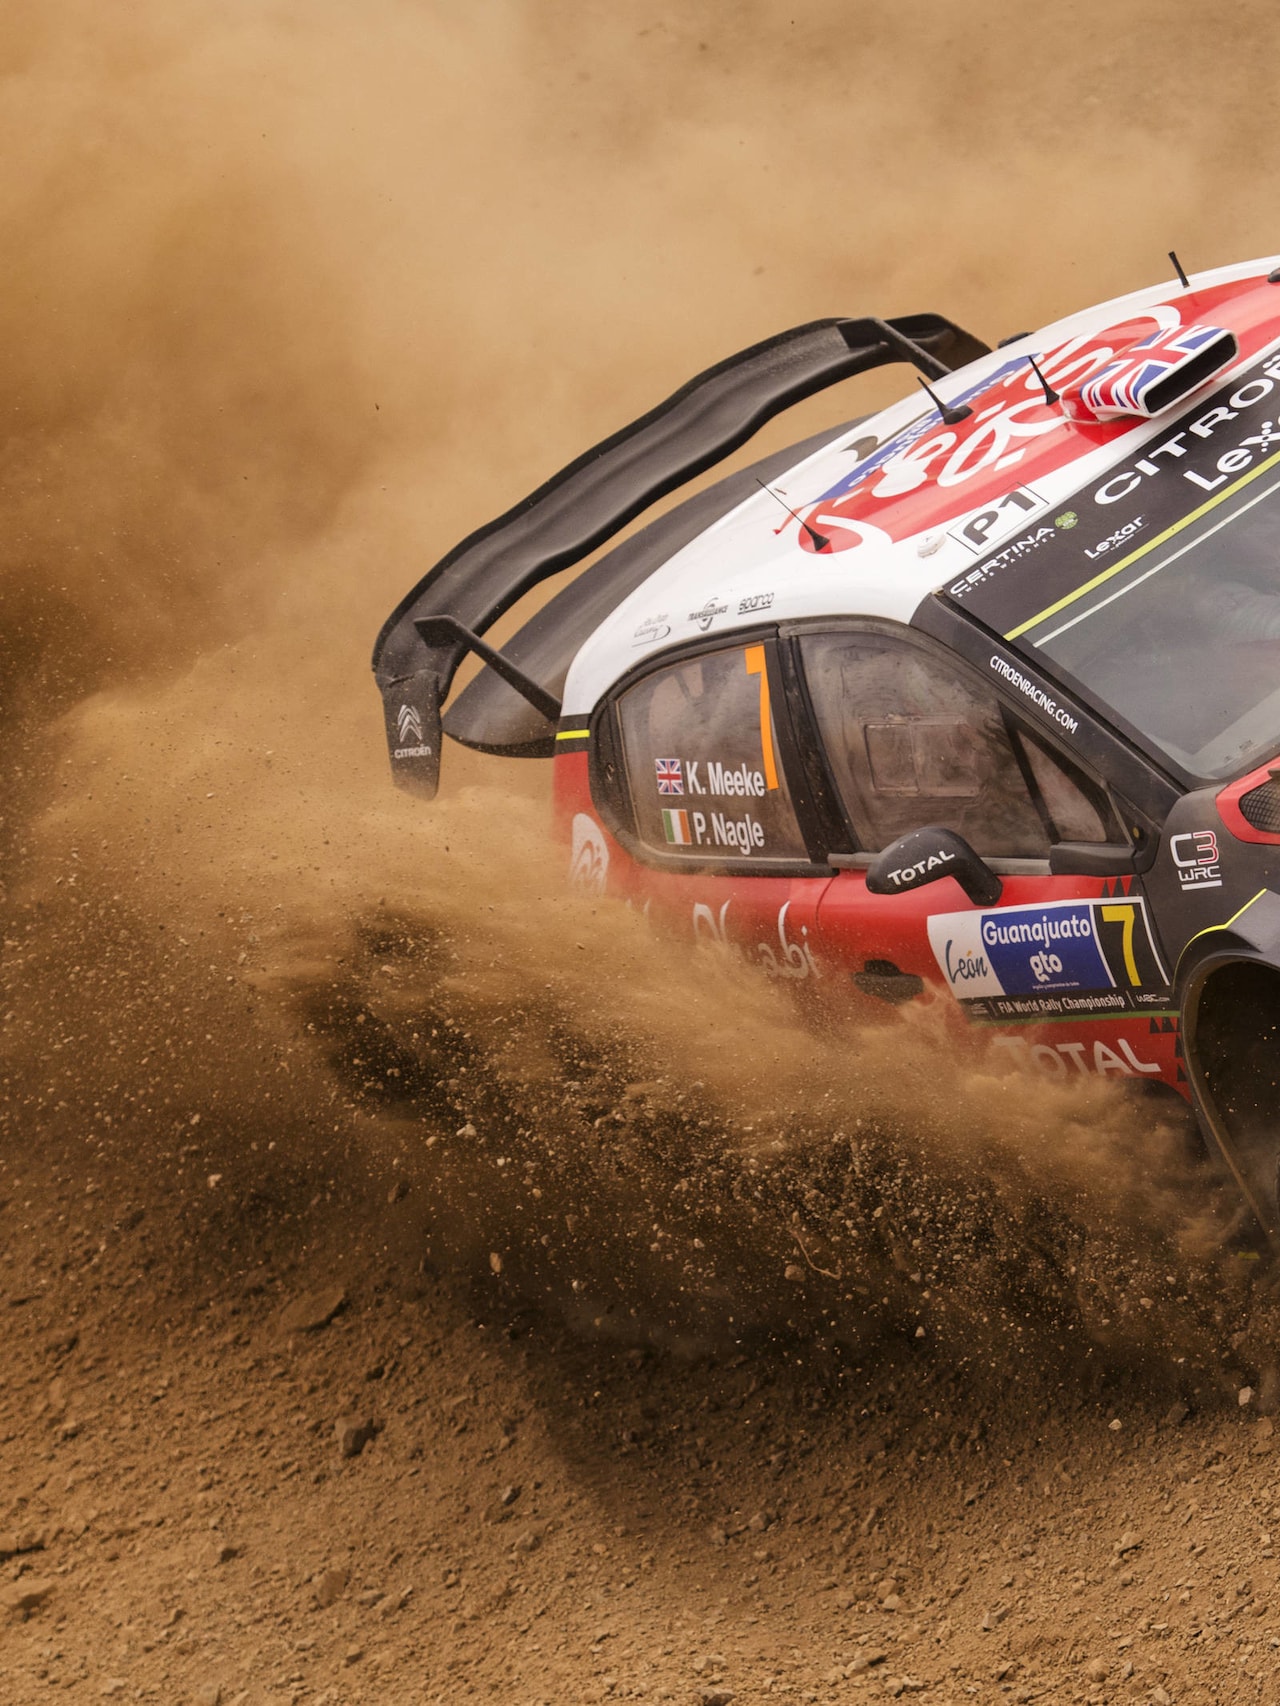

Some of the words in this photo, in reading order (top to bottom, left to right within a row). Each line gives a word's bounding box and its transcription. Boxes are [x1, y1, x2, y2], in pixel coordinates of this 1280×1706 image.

[848, 370, 1015, 487] Guaajuato
[963, 491, 1037, 546] P1
[1084, 515, 1144, 559] Lexar
[950, 528, 1055, 595] CERTINA
[989, 655, 1079, 735] CITROENRACING.COM
[686, 760, 707, 796] K.
[708, 761, 765, 798] Meeke
[693, 812, 711, 845] P.
[712, 815, 765, 856] Nagle
[1170, 830, 1219, 867] C3
[887, 850, 955, 887] TOTAL
[1178, 865, 1221, 882] WRC
[982, 914, 1092, 949] Guanajuato
[1101, 904, 1142, 987] 7
[945, 939, 988, 984] León
[1029, 950, 1063, 983] gto
[998, 1001, 1014, 1014] FIA
[1014, 999, 1040, 1014] World
[1041, 998, 1063, 1014] Rally
[1063, 993, 1127, 1011] Championship
